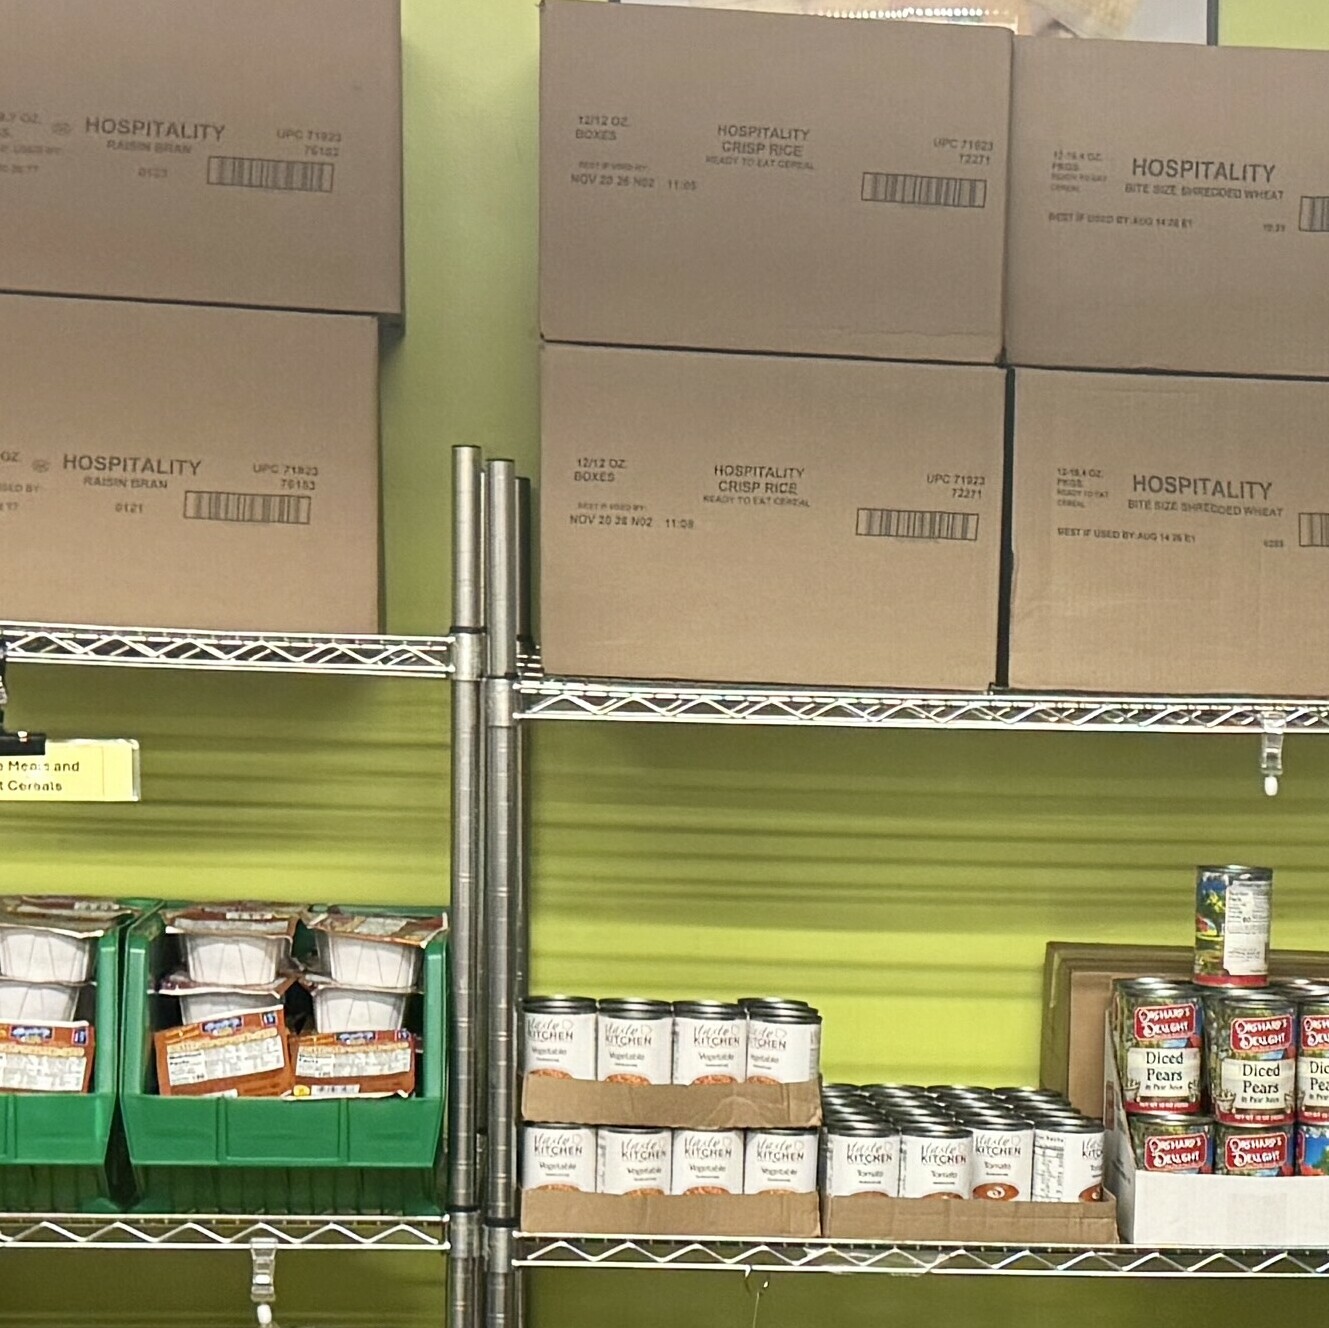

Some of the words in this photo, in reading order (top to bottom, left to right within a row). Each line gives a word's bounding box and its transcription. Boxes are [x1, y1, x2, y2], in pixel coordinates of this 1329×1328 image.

[86, 116, 225, 142] HOSPITALITY
[717, 124, 810, 141] HOSPITALITY
[721, 141, 766, 156] CRISP
[768, 143, 803, 157] RICE
[1132, 158, 1277, 184] HOSPITALITY
[62, 454, 202, 477] HOSPITALITY
[714, 464, 805, 480] HOSPITALITY
[573, 471, 616, 483] BOXES
[718, 480, 761, 494] CRISP
[764, 482, 799, 496] RICE
[1132, 474, 1274, 501] HOSPITALITY
[1145, 1050, 1184, 1066] Diced
[1146, 1067, 1183, 1082] Pears
[1242, 1063, 1281, 1078] Diced
[1243, 1079, 1280, 1094] Pears
[534, 1145, 583, 1158] KITCHEN
